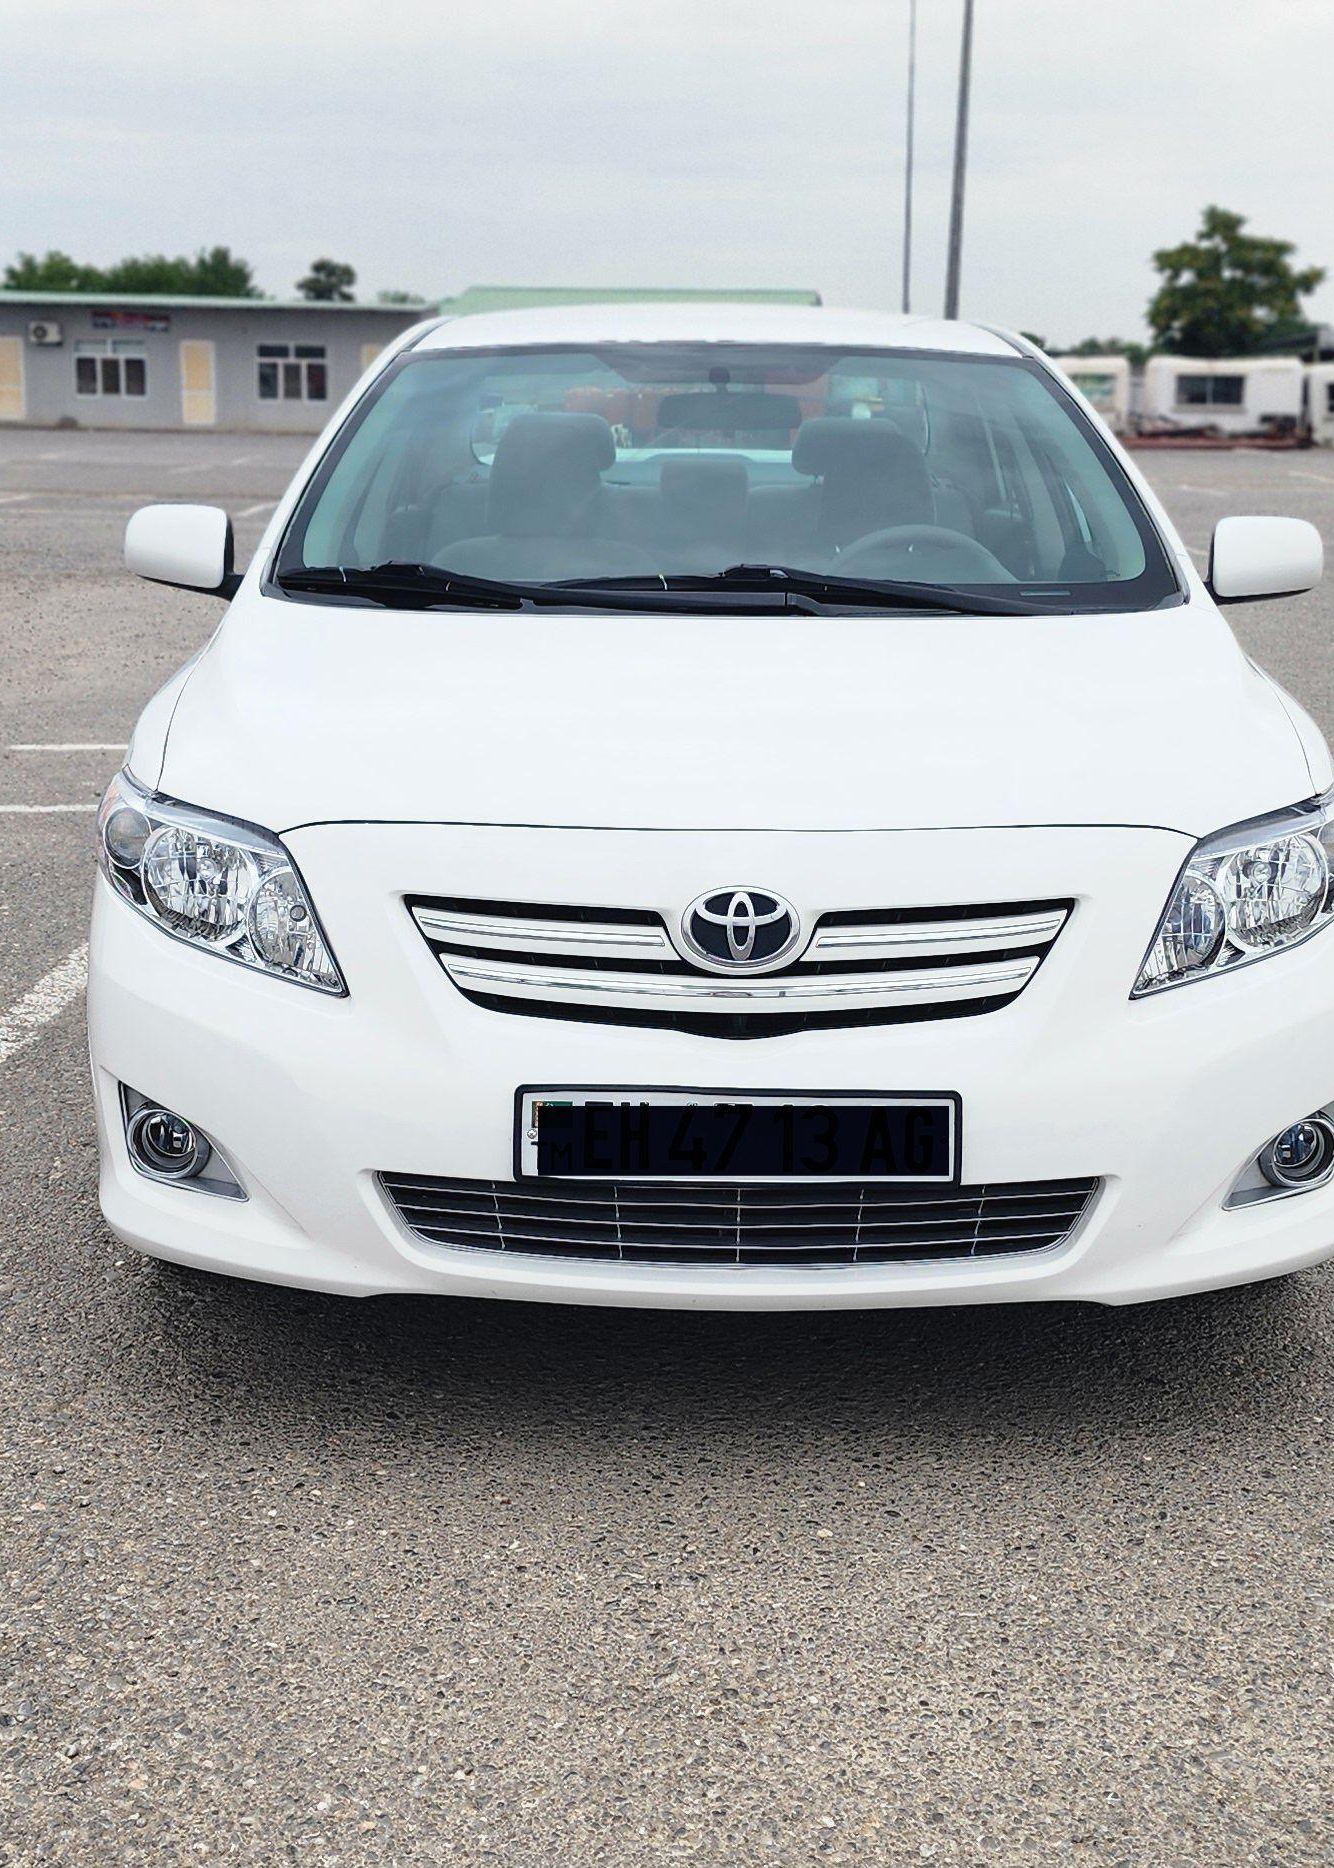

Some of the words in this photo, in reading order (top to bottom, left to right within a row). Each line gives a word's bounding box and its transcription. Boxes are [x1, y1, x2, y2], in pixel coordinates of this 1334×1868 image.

[584, 1102, 651, 1170] EH
[667, 1103, 755, 1172] 47
[772, 1104, 840, 1173] 13
[859, 1105, 935, 1173] AG
